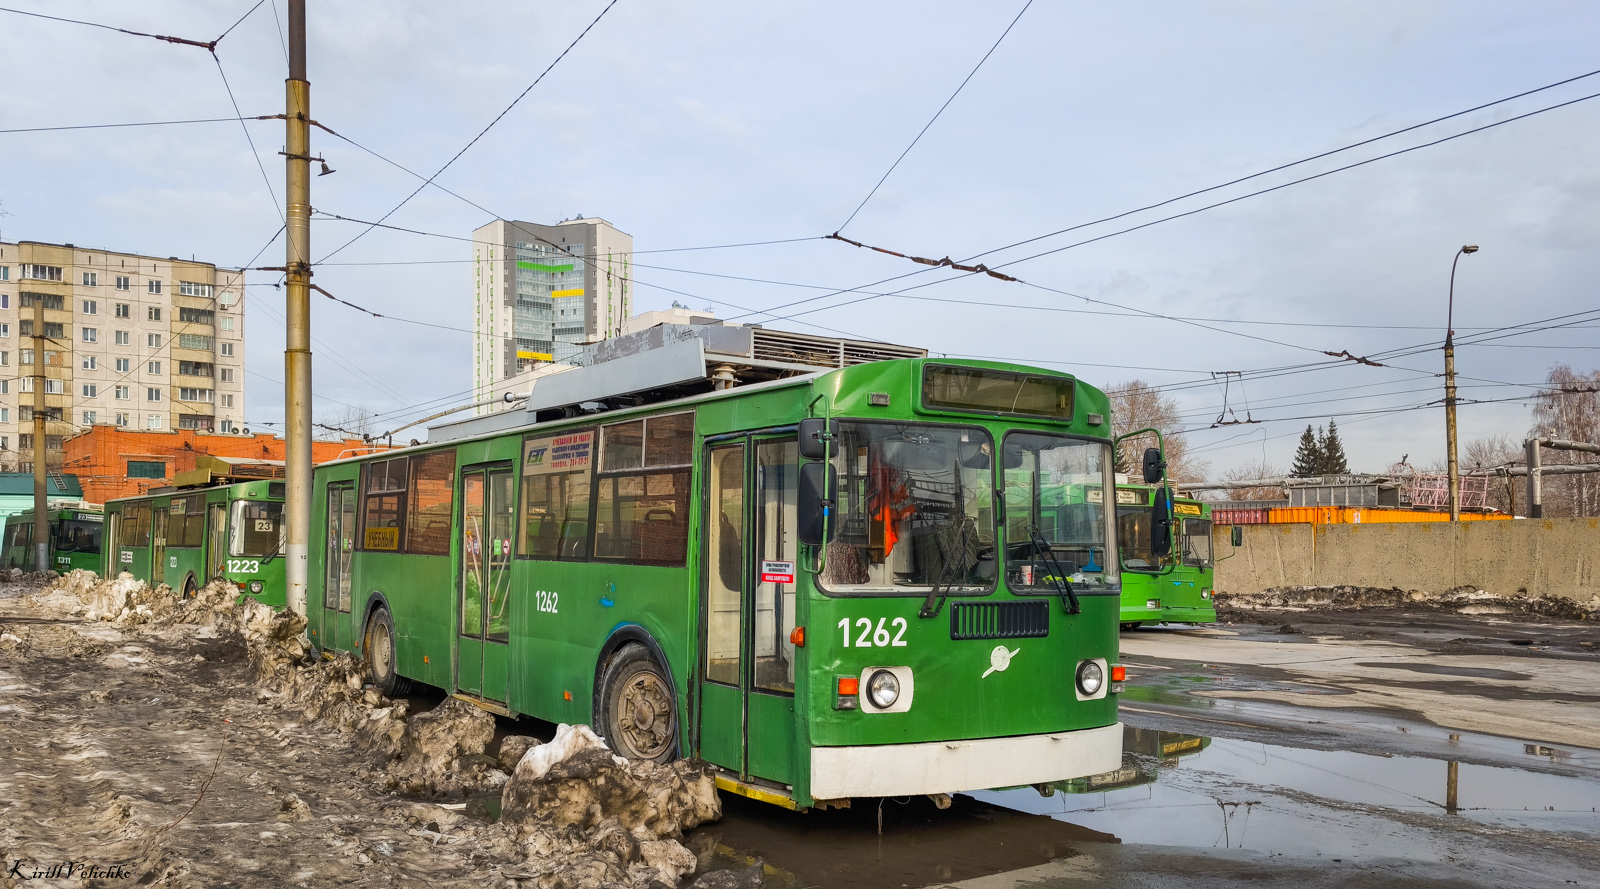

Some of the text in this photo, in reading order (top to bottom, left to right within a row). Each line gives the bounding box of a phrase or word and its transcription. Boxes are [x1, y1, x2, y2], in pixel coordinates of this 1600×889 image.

[257, 522, 271, 531] 23
[57, 556, 71, 565] 1311
[226, 560, 259, 574] 1223
[535, 590, 559, 614] 1262
[837, 616, 908, 648] 1262
